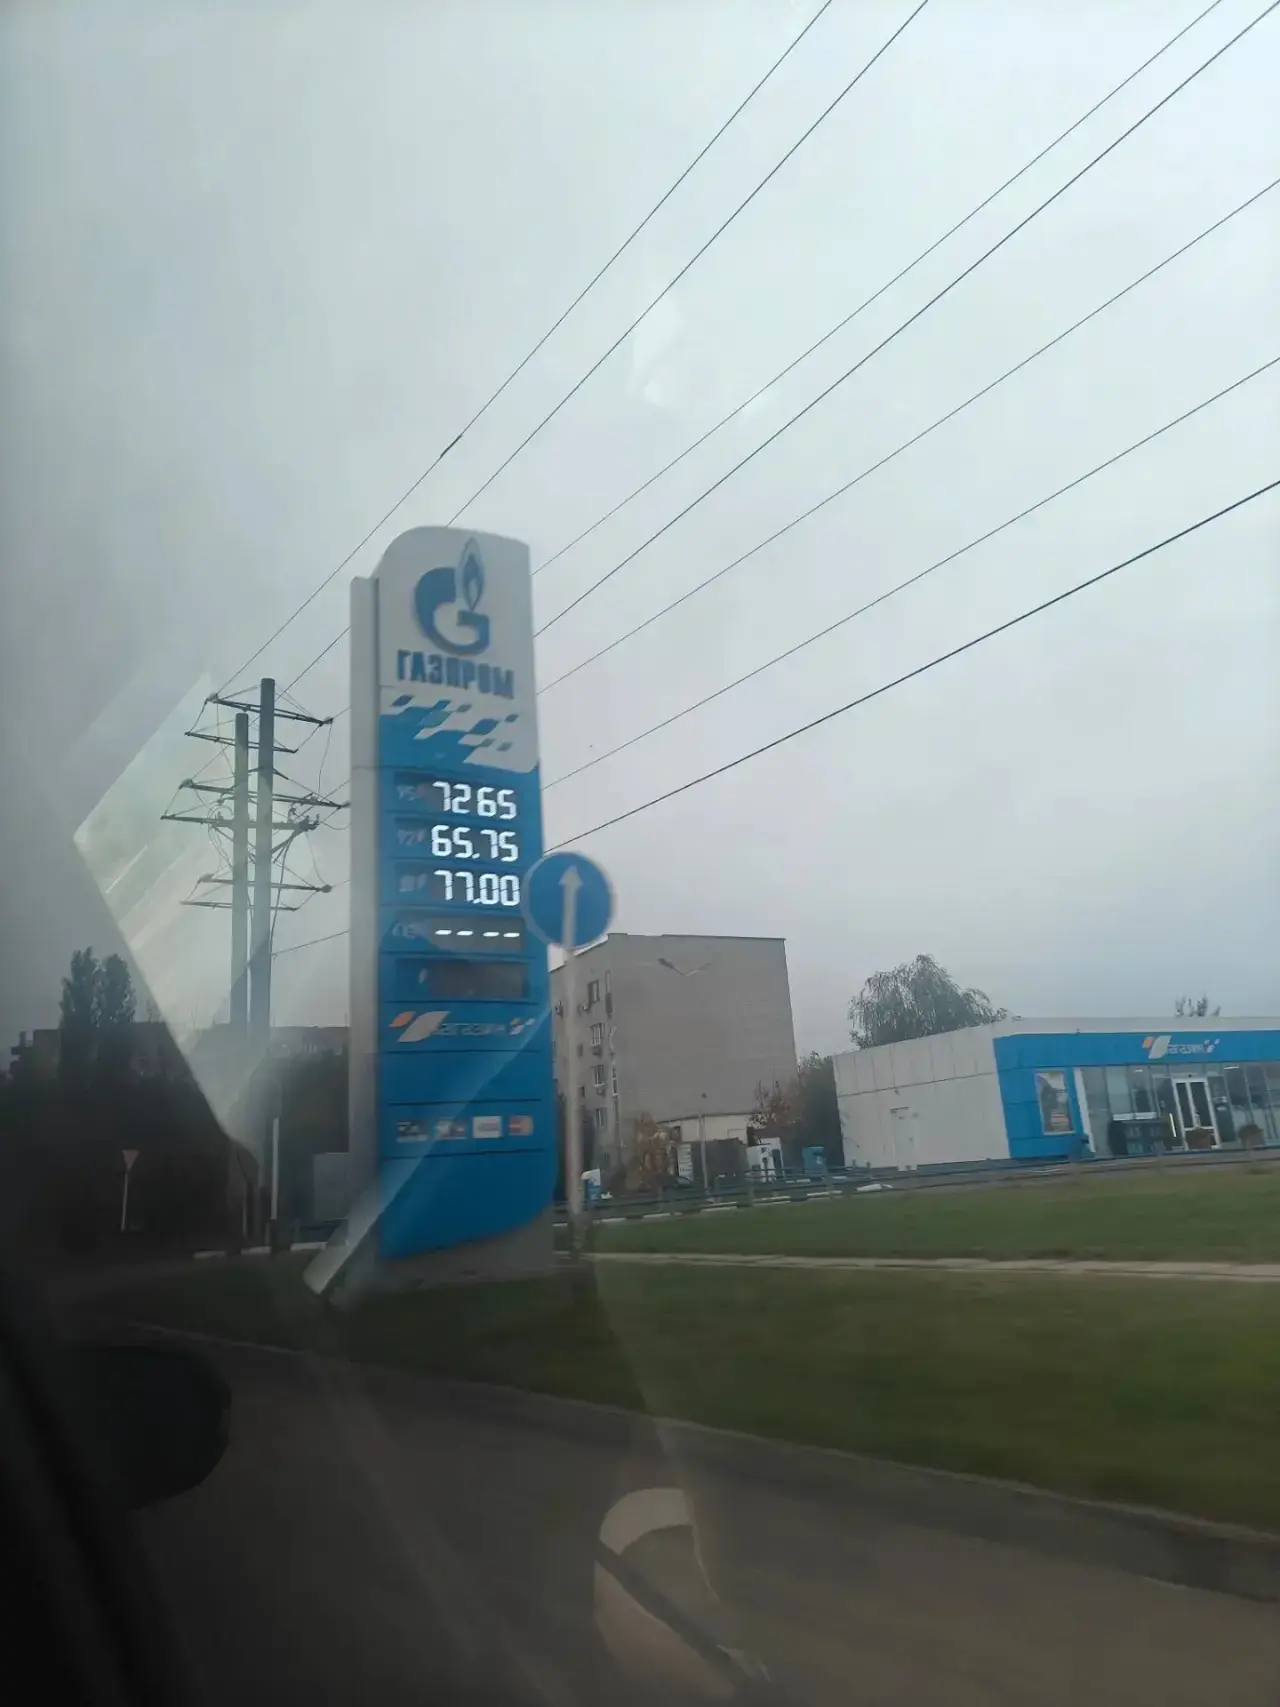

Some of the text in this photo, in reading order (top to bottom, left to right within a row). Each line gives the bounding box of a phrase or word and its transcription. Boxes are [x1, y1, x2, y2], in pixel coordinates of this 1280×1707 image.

[396, 648, 515, 701] ГАЗПРОМ
[431, 824, 519, 862] 65.75
[433, 869, 521, 907] 77.00
